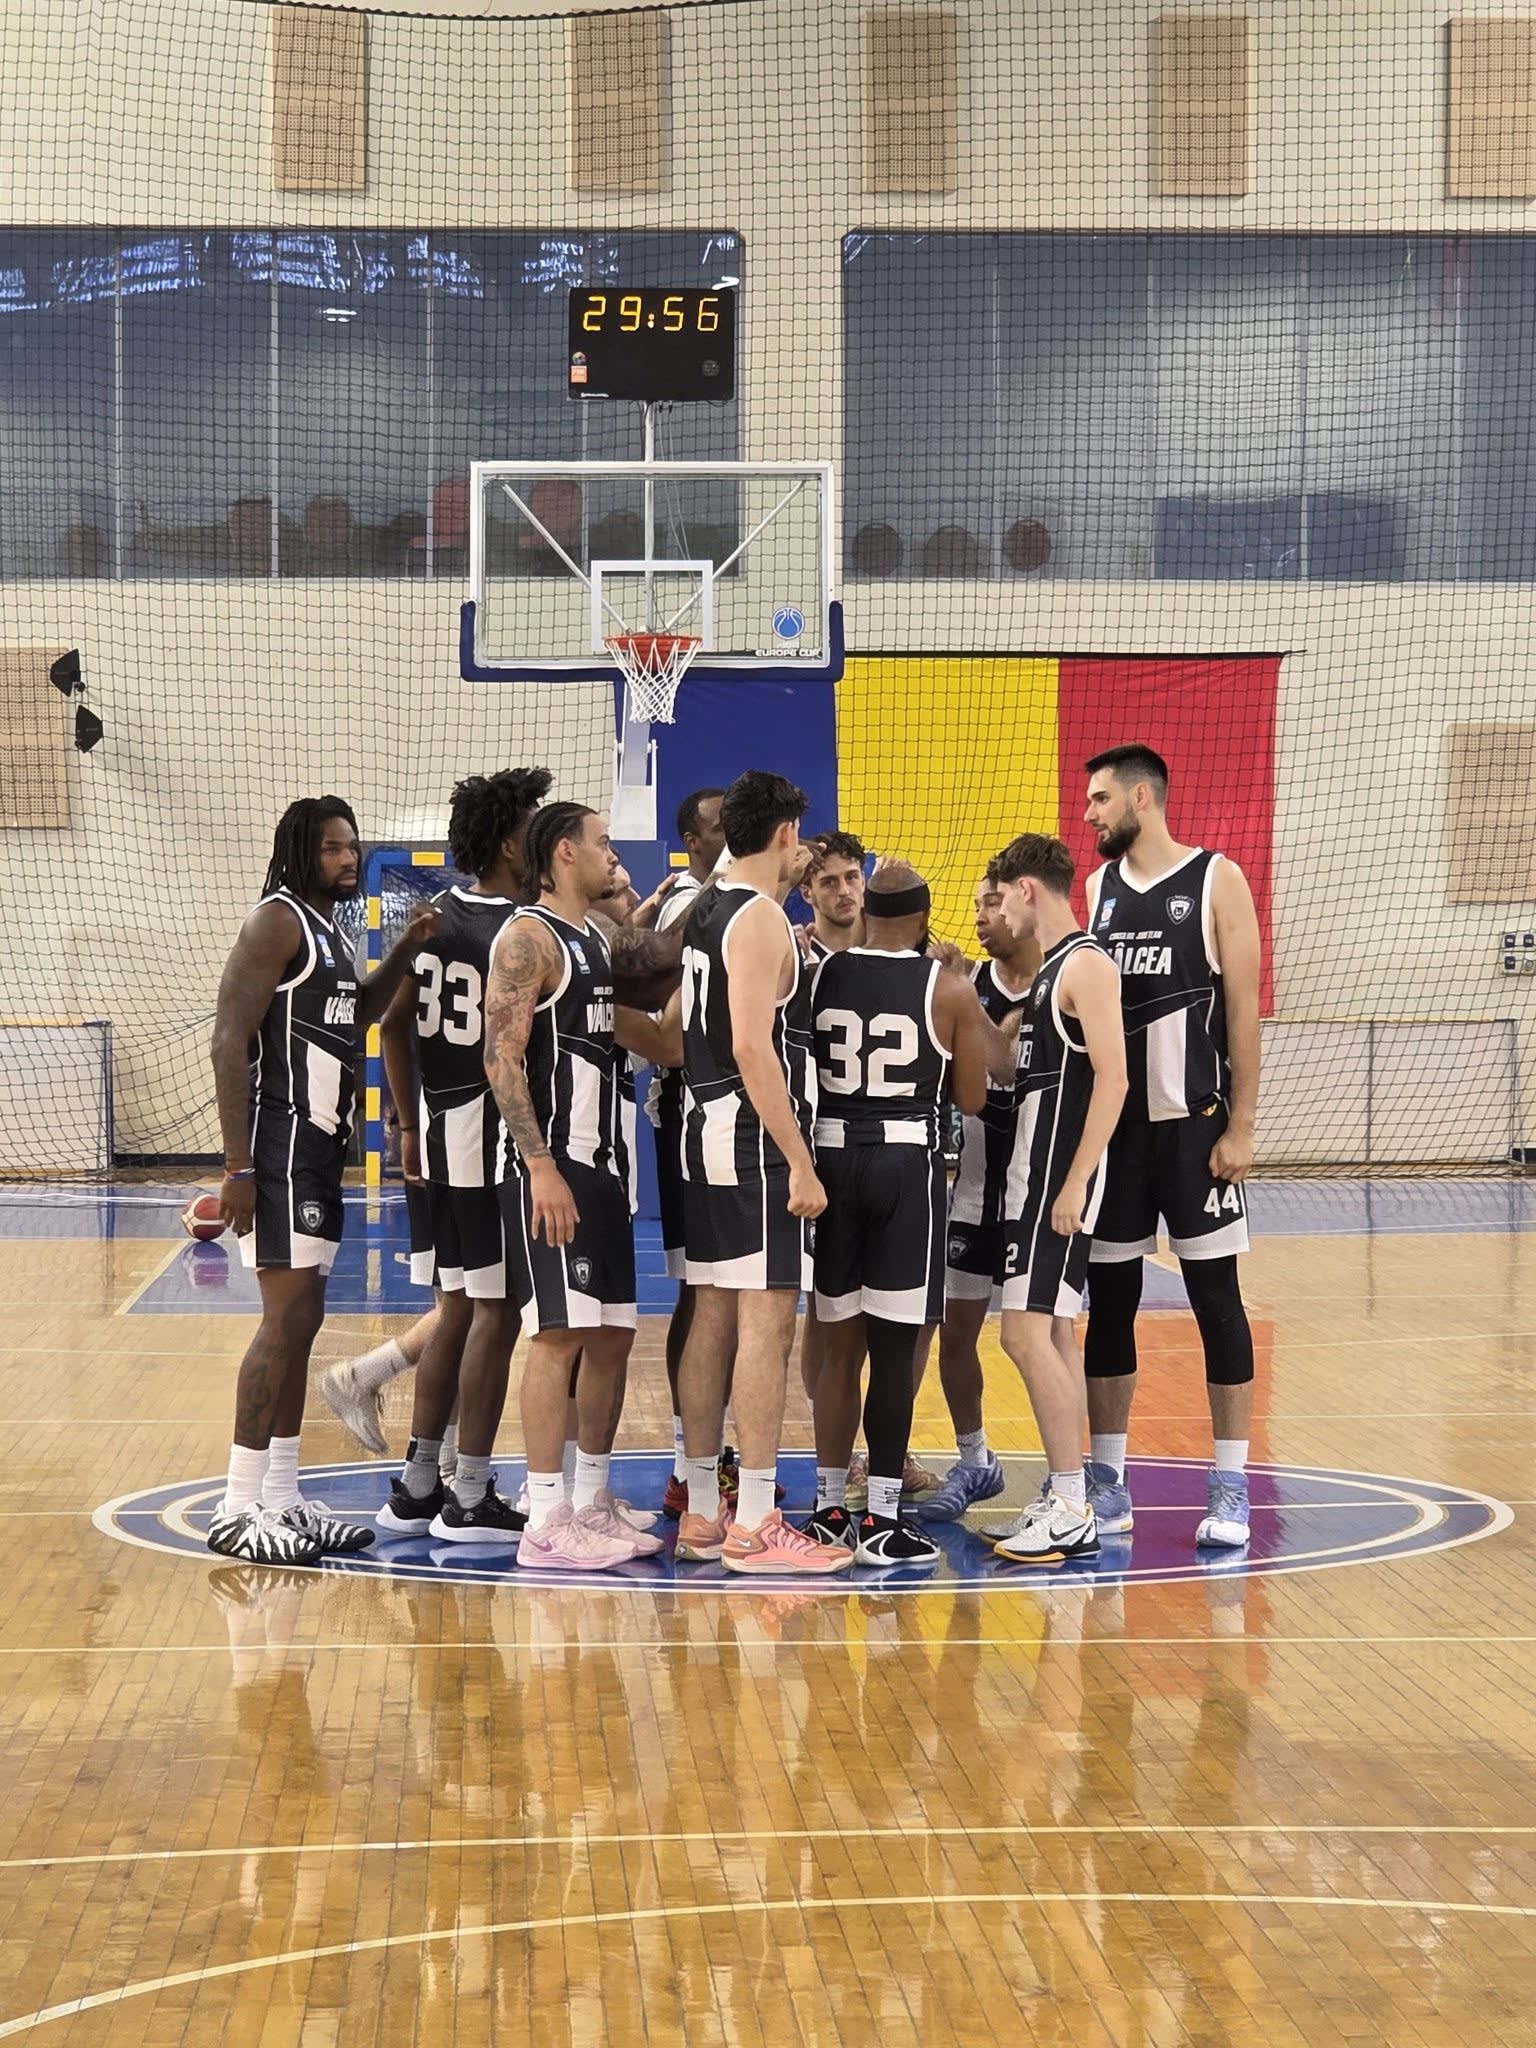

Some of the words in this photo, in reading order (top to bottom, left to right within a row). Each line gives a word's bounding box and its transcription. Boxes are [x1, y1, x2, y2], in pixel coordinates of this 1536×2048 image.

[582, 296, 719, 331] 29:56
[755, 648, 797, 657] EUROPE
[799, 647, 820, 657] CUP
[415, 951, 482, 1047] 33
[816, 1008, 919, 1098] 32
[1203, 1184, 1240, 1218] 44
[1004, 1243, 1019, 1273] 2
